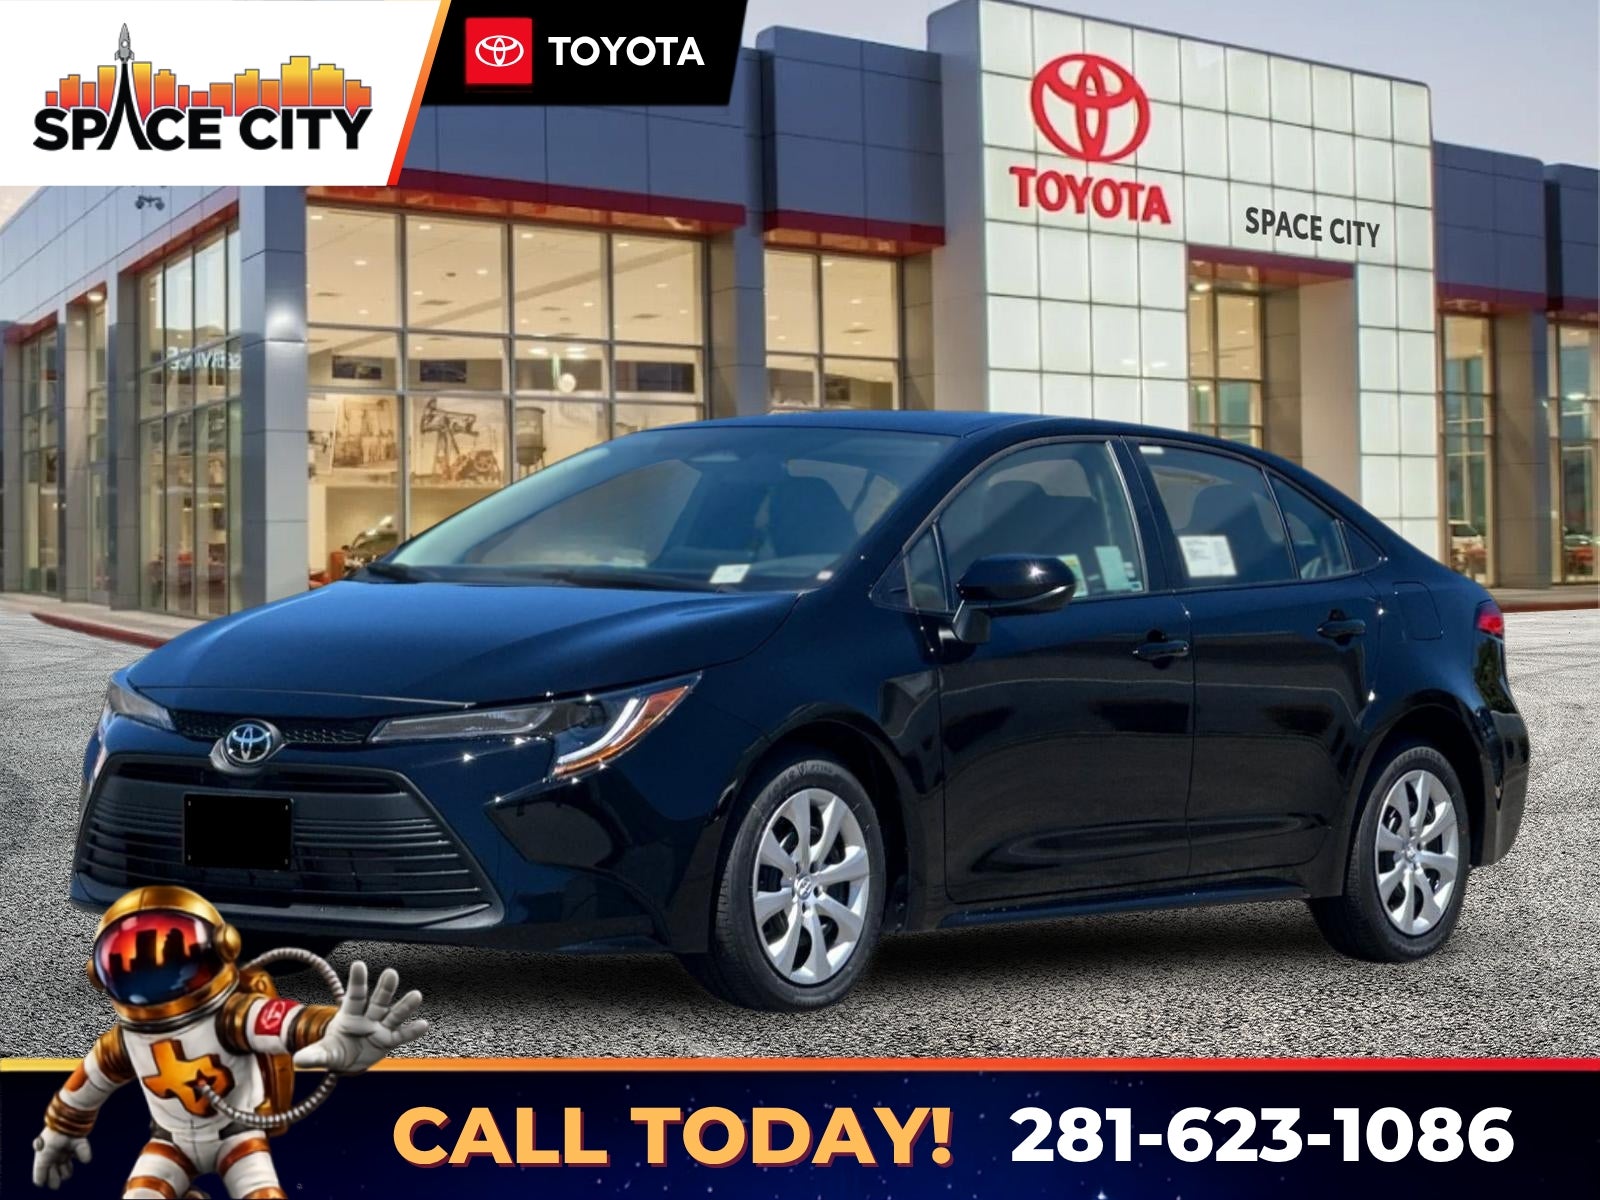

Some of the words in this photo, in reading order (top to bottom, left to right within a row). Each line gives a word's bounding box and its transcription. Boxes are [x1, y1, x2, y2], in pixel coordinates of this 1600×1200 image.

[1008, 164, 1172, 225] TOYOTA
[1244, 206, 1323, 242] SPACE
[1329, 217, 1381, 249] CITY
